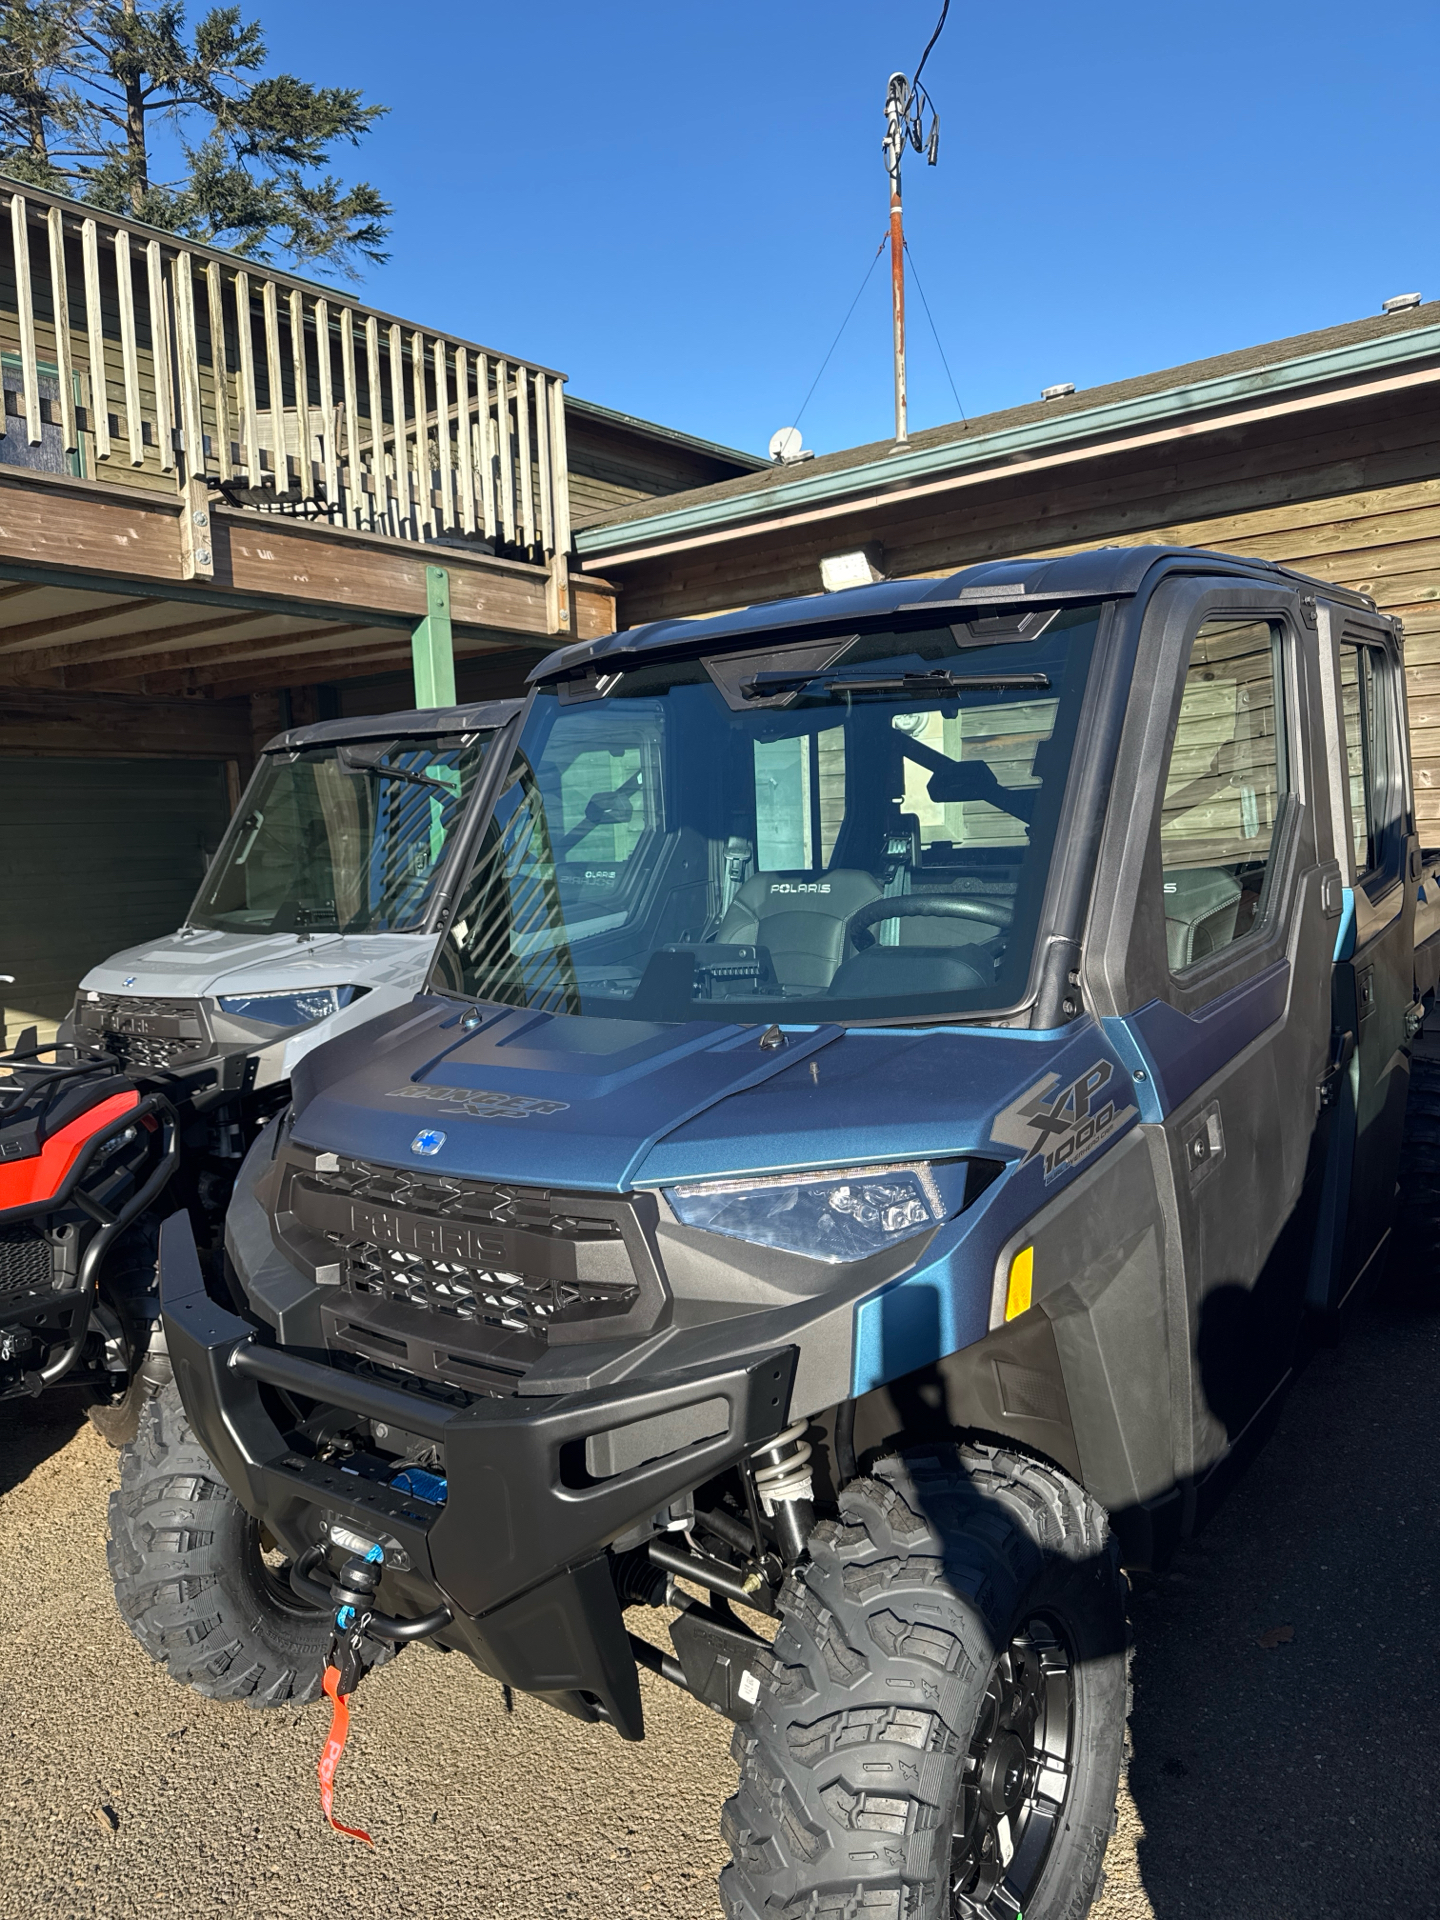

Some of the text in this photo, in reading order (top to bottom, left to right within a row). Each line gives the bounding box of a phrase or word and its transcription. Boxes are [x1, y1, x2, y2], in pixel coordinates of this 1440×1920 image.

[770, 883, 831, 894] POLARIS
[385, 1085, 570, 1115] RANGER
[438, 1102, 529, 1118] XP
[1013, 1058, 1114, 1175] XP
[1045, 1101, 1114, 1174] 1000
[351, 1205, 508, 1264] POLARIS
